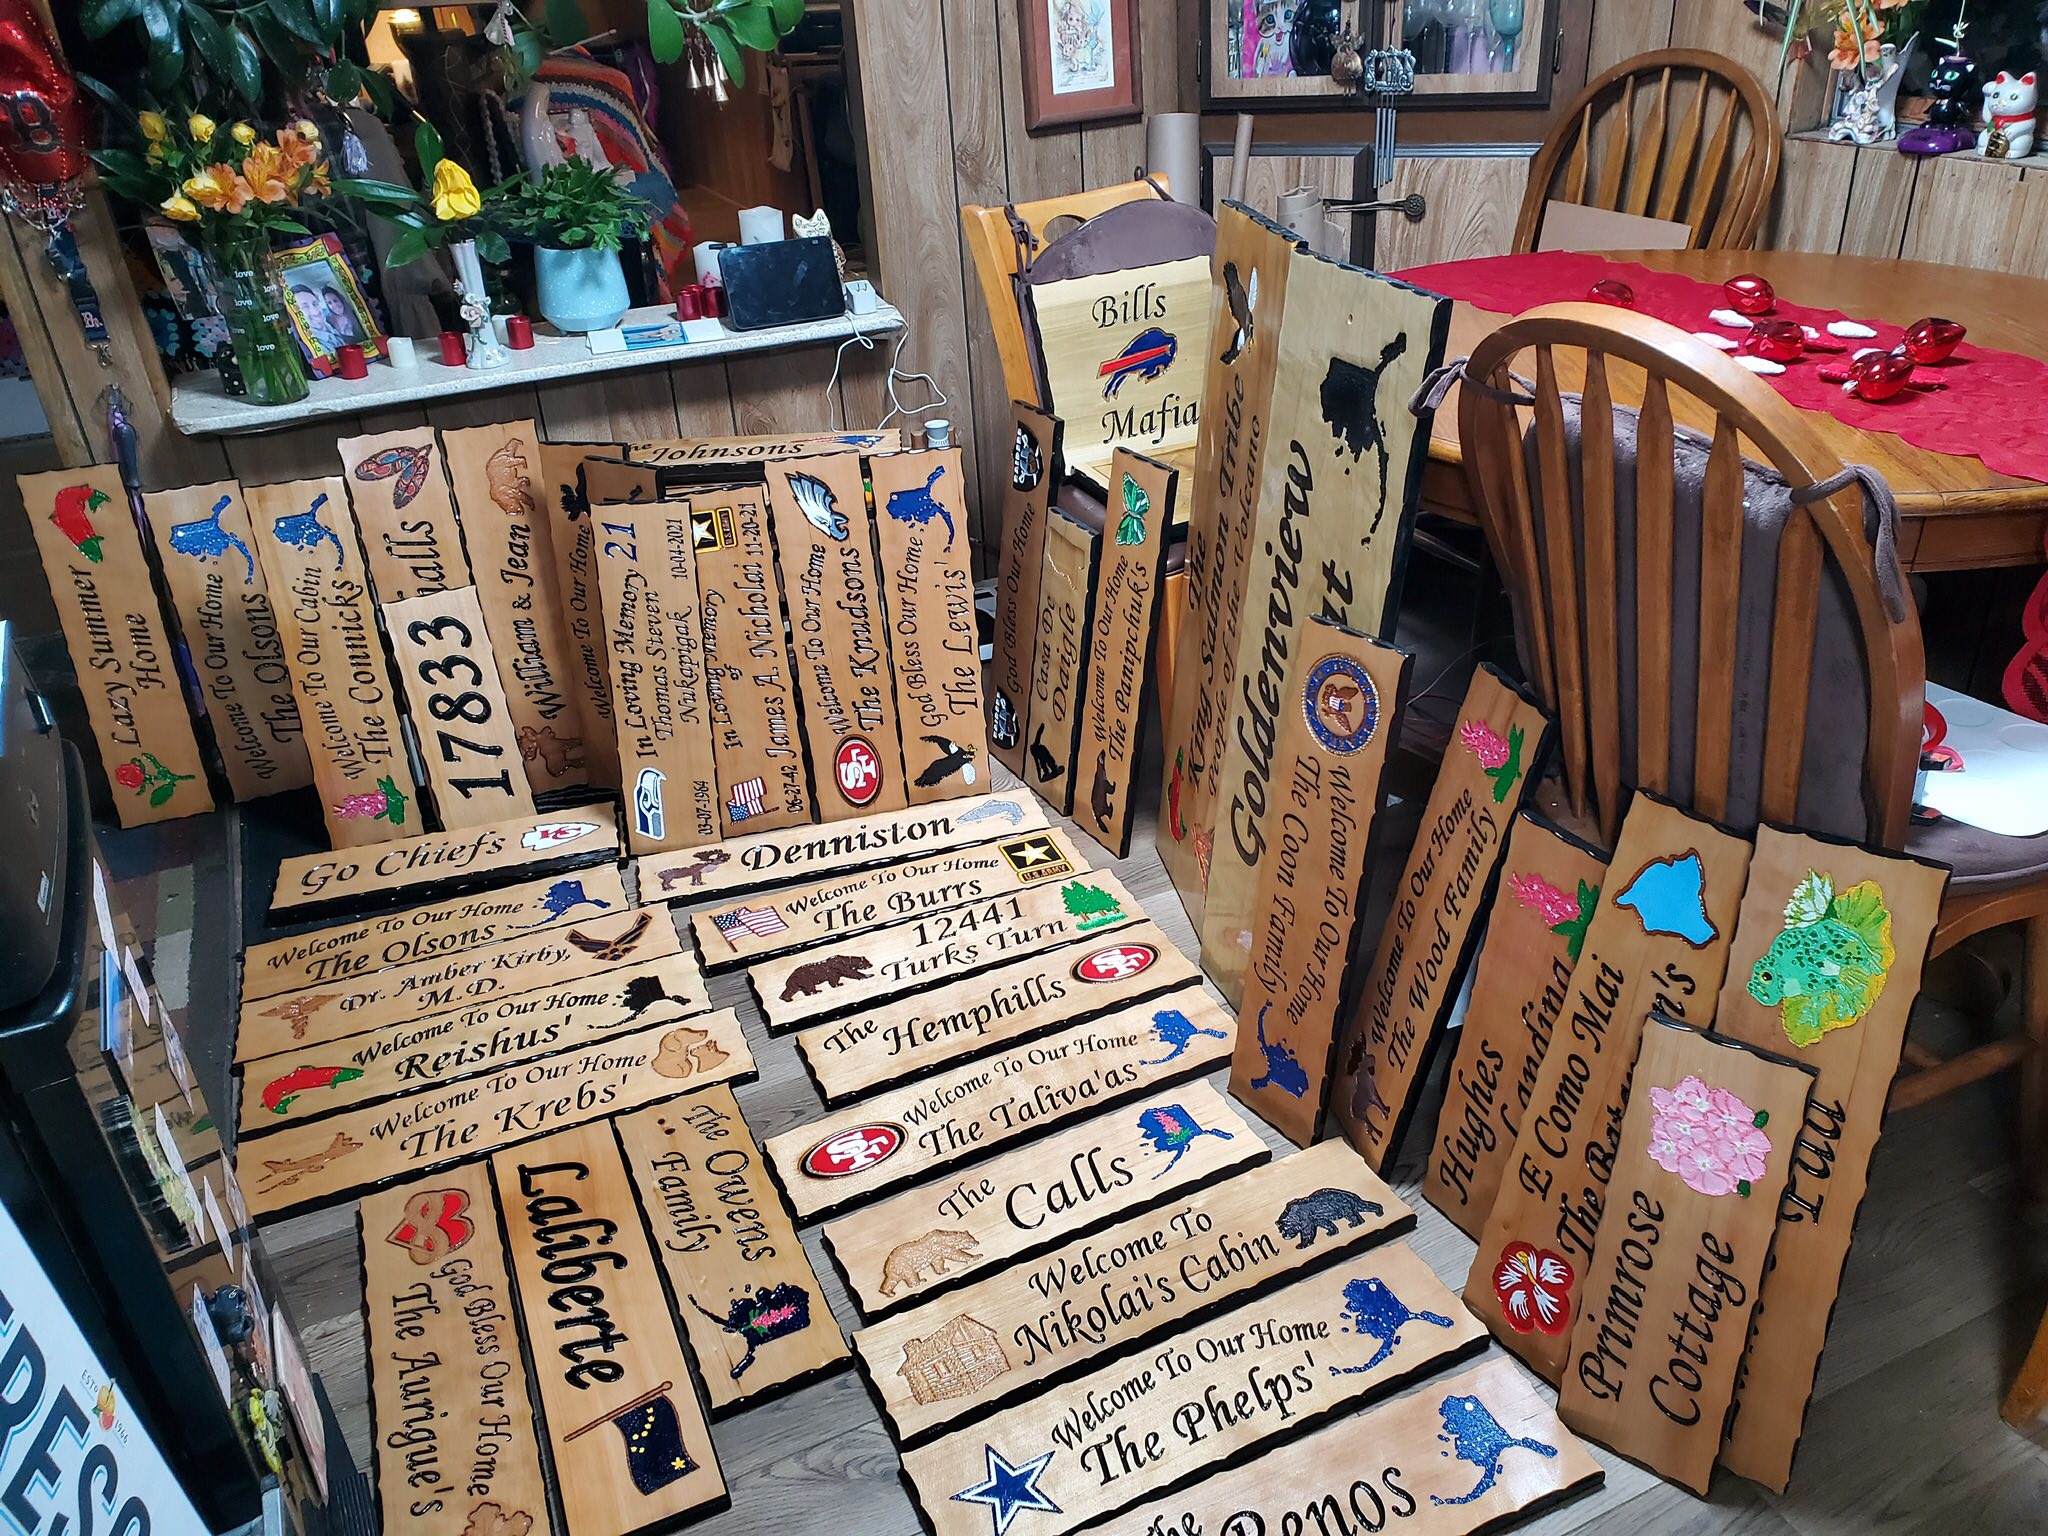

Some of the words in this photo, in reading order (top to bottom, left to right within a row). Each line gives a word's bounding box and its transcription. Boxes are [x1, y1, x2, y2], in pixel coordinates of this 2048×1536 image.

[234, 270, 254, 278] love
[262, 312, 280, 322] love
[1092, 282, 1167, 329] Bills
[1102, 393, 1200, 444] Mafia
[643, 440, 805, 464] Johnsons
[1234, 415, 1260, 568] Volcano
[500, 523, 535, 588] Jean
[601, 521, 639, 563] 21
[666, 518, 688, 580] 10-04-2021
[737, 502, 764, 556] 11-20-21
[1012, 502, 1036, 558] Home
[292, 566, 322, 625] Cabin
[800, 543, 827, 597] Home
[896, 537, 924, 594] Home
[1007, 558, 1022, 594] Our
[1106, 554, 1129, 605] Home
[1188, 531, 1206, 610] The
[1188, 683, 1213, 792] King
[1201, 512, 1229, 685] Salmon
[1220, 373, 1244, 499] Tribe
[68, 564, 122, 673] Summer
[512, 593, 533, 610] &
[614, 568, 648, 655] Memory
[645, 590, 668, 661] Steven
[703, 589, 725, 661] Memory
[734, 563, 777, 659] Nicholai
[801, 595, 822, 633] Our
[836, 547, 879, 679] Knudsons
[897, 597, 917, 636] Our
[933, 561, 973, 655] Lewis'
[1003, 598, 1017, 650] Bless
[1098, 602, 1114, 638] Our
[1229, 578, 1241, 638] the
[125, 613, 165, 689] Home
[241, 592, 289, 685] Olsons
[296, 627, 321, 666] Our
[323, 578, 384, 706] Connicks
[667, 605, 700, 724] Nukapigak
[804, 638, 826, 660] To
[899, 641, 928, 690] Bless
[1052, 603, 1077, 722] Daigle
[1094, 640, 1107, 663] To
[1115, 561, 1150, 714] Panipchuk's
[1222, 630, 1236, 685] of
[1230, 439, 1314, 867] Goldenview
[300, 672, 327, 697] To
[512, 617, 566, 721] William
[616, 660, 649, 730] Loving
[706, 667, 733, 725] Loving
[724, 663, 743, 680] of
[753, 666, 786, 692] A.
[813, 663, 852, 735] Welcome
[942, 666, 978, 716] The
[1003, 647, 1023, 696] God
[1036, 641, 1050, 702] Casa
[104, 681, 141, 748] Lazy
[260, 694, 303, 743] The
[408, 616, 516, 799] 17833
[649, 664, 674, 741] Thomas
[766, 696, 797, 759] James
[851, 685, 884, 733] The
[919, 696, 948, 728] God
[1091, 665, 1105, 743] Welcome
[315, 701, 366, 781] Welcome
[354, 714, 393, 766] The
[635, 735, 659, 758] In
[723, 729, 744, 750] In
[1109, 718, 1126, 762] The
[1208, 689, 1227, 797] People
[693, 780, 714, 836] 03-07-1964
[781, 765, 804, 813] 06-27-42
[1294, 755, 1321, 806] The
[740, 816, 957, 872] Denniston
[1277, 812, 1309, 888] Coon
[1328, 765, 1356, 881] Welcome
[301, 863, 359, 896] Go
[375, 831, 506, 877] Chiefs
[785, 879, 869, 917] Welcome
[871, 869, 898, 888] To
[901, 859, 939, 879] Our
[942, 855, 1000, 872] Home
[812, 901, 878, 934] The
[887, 877, 983, 916] Burrs
[912, 897, 1027, 948] 12441
[1329, 886, 1350, 922] To
[267, 928, 370, 972] Welcome
[376, 915, 405, 935] To
[411, 909, 455, 932] Our
[458, 900, 523, 920] Home
[305, 950, 370, 983] The
[382, 924, 497, 965] Olsons
[881, 941, 981, 984] Turks
[985, 915, 1069, 953] Turn
[1253, 892, 1295, 994] Family
[1312, 921, 1341, 969] Our
[1387, 1014, 1416, 1074] The
[1408, 909, 1450, 1012] Wood
[1444, 805, 1496, 921] Family
[340, 988, 386, 1013] Dr.
[393, 959, 487, 1000] Amber
[492, 945, 571, 970] Kirby,
[417, 988, 462, 1011] M.
[466, 977, 505, 995] D.
[1291, 964, 1327, 1026] Home
[1572, 953, 1625, 1054] Mai
[351, 1019, 455, 1066] Welcome
[459, 1006, 489, 1028] To
[496, 996, 539, 1018] Our
[545, 990, 609, 1010] Home
[823, 1015, 880, 1057] The
[881, 972, 1069, 1058] Hemphills
[394, 1013, 573, 1083] Reishus'
[903, 1071, 992, 1127] Welcome
[994, 1057, 1024, 1080] To
[1027, 1044, 1070, 1067] Our
[1073, 1034, 1139, 1057] Home
[918, 1116, 985, 1159] The
[988, 1062, 1139, 1129] Taliva'as
[1534, 1053, 1590, 1158] Como
[399, 1117, 480, 1162] The
[496, 1072, 631, 1135] Krebs'
[682, 1105, 732, 1141] The
[1439, 1038, 1504, 1206] Hughes
[651, 1151, 722, 1254] Family
[704, 1149, 777, 1262] Owens
[938, 1176, 998, 1221] The
[1004, 1146, 1136, 1231] Calls
[1518, 1152, 1552, 1202] E
[1028, 1230, 1169, 1300] Welcome
[1171, 1207, 1214, 1242] To
[1556, 1192, 1601, 1262] The
[429, 1257, 494, 1298] God
[517, 1160, 629, 1391] Laliberte
[1013, 1269, 1177, 1370] Nikolai's
[1177, 1228, 1283, 1296] Cabin
[1578, 1190, 1665, 1404] Primrose
[391, 1282, 443, 1342] The
[463, 1298, 500, 1356] Bless
[1649, 1231, 1746, 1428] Cottage
[479, 1360, 512, 1406] Our
[1051, 1369, 1157, 1453] Welcome
[1155, 1347, 1193, 1380] To
[1196, 1332, 1247, 1363] Our
[1250, 1318, 1331, 1350] Home
[115, 1420, 129, 1443] 1966
[386, 1350, 455, 1517] Aurigue's
[1080, 1424, 1166, 1488] The
[1172, 1349, 1316, 1447] Phelps'
[466, 1414, 512, 1497] Home
